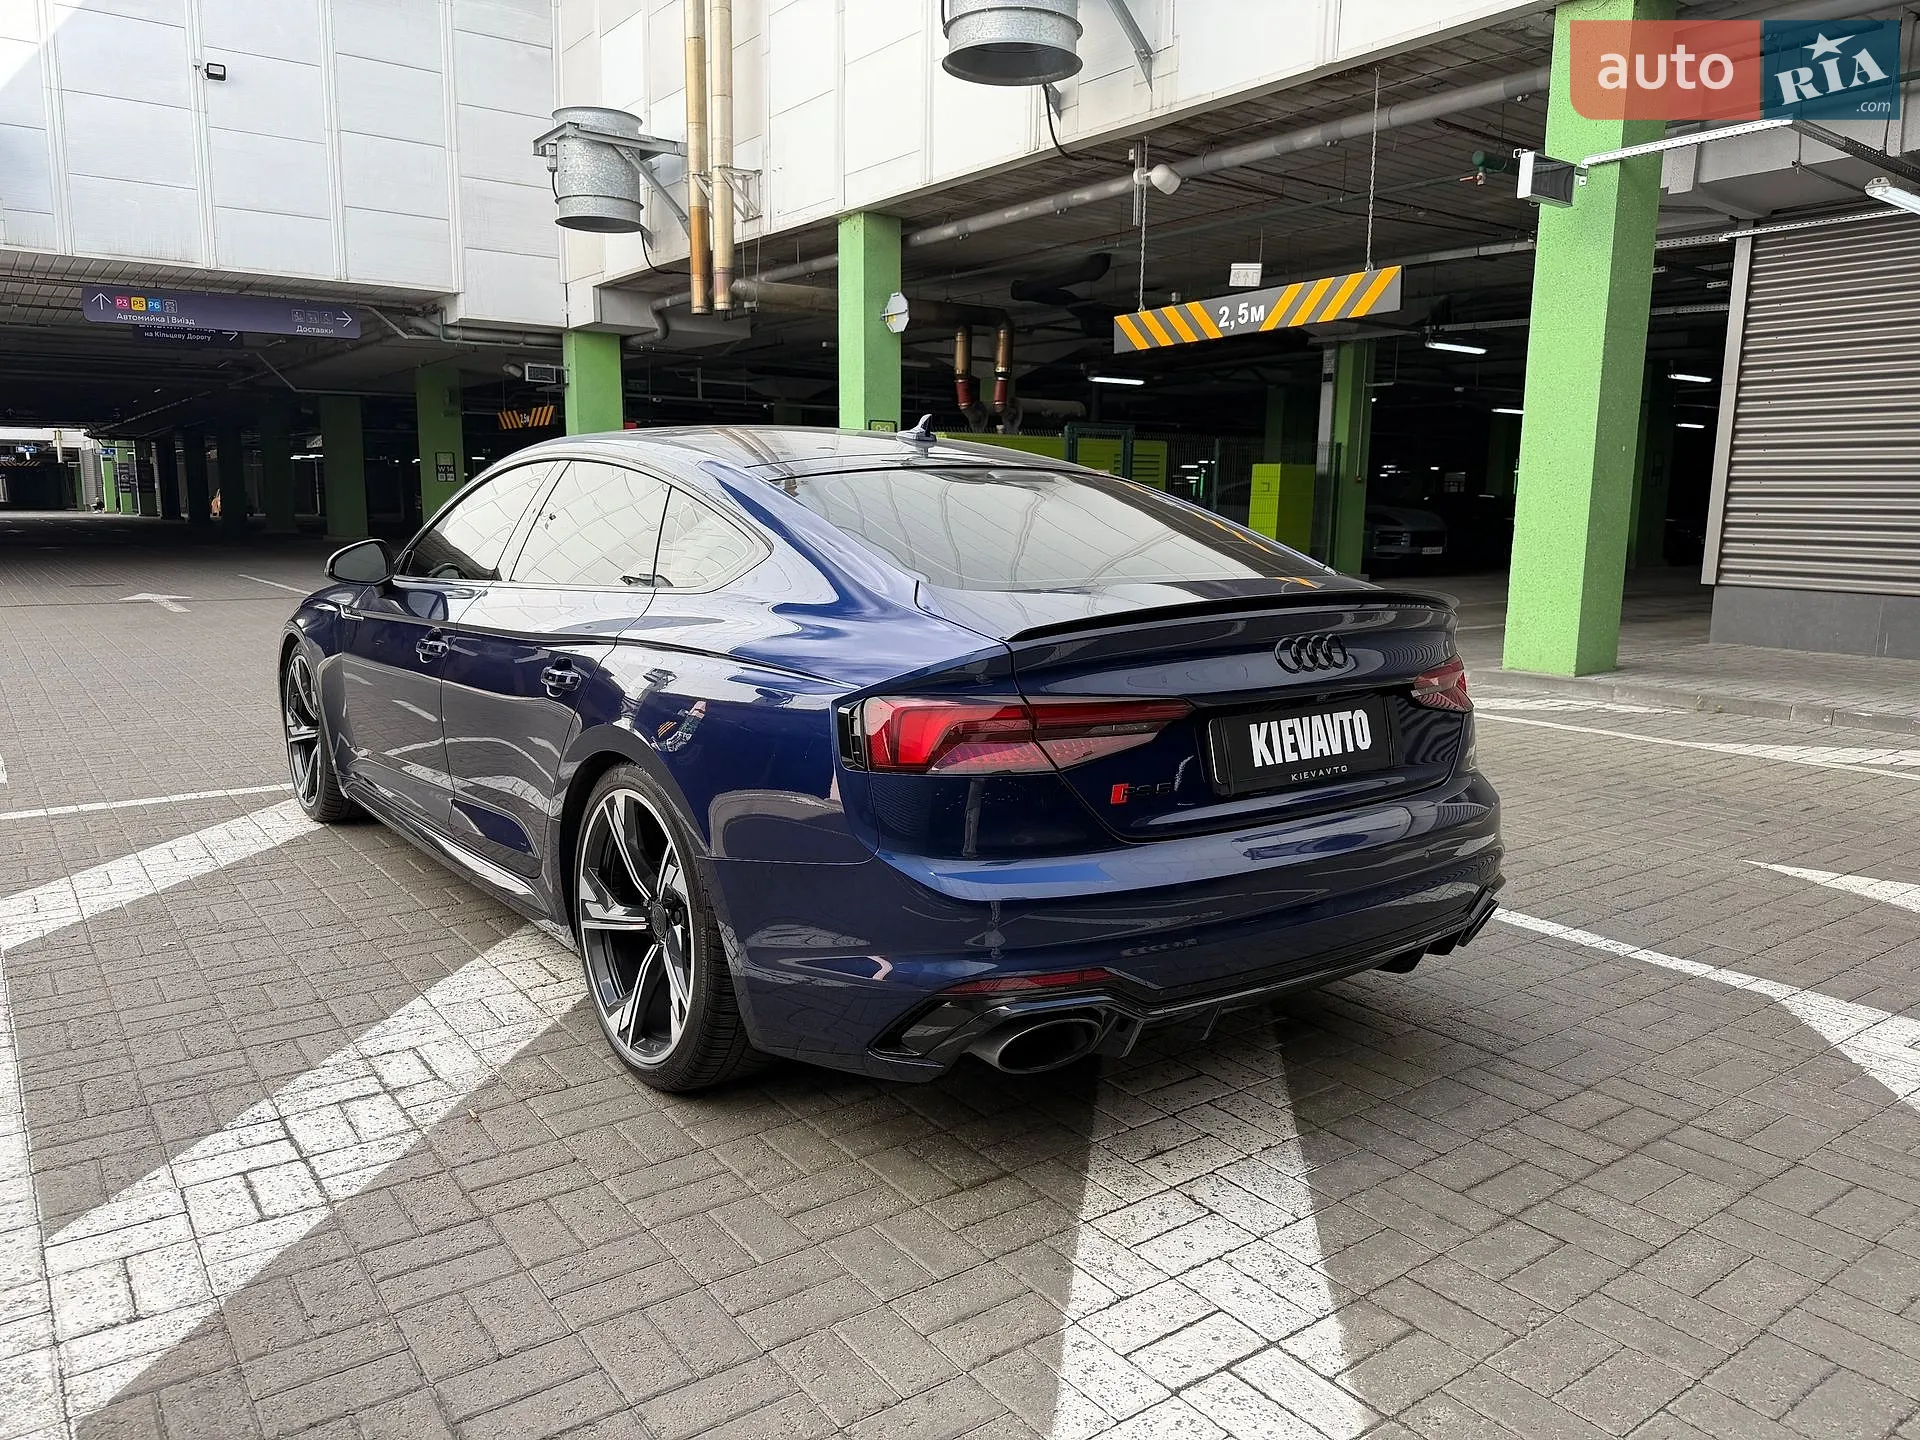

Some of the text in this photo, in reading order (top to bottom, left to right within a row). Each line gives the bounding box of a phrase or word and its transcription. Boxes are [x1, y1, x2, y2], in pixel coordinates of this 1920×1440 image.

[116, 298, 160, 309] P3 P5 P6
[116, 312, 195, 326] Автомийка Виїзд
[296, 325, 334, 335] Доставки
[154, 331, 186, 340] Кільцеву
[187, 333, 212, 342] Дорогу
[1249, 709, 1372, 768] KIEVAVTO
[1291, 764, 1348, 782] KIEVAVTO
